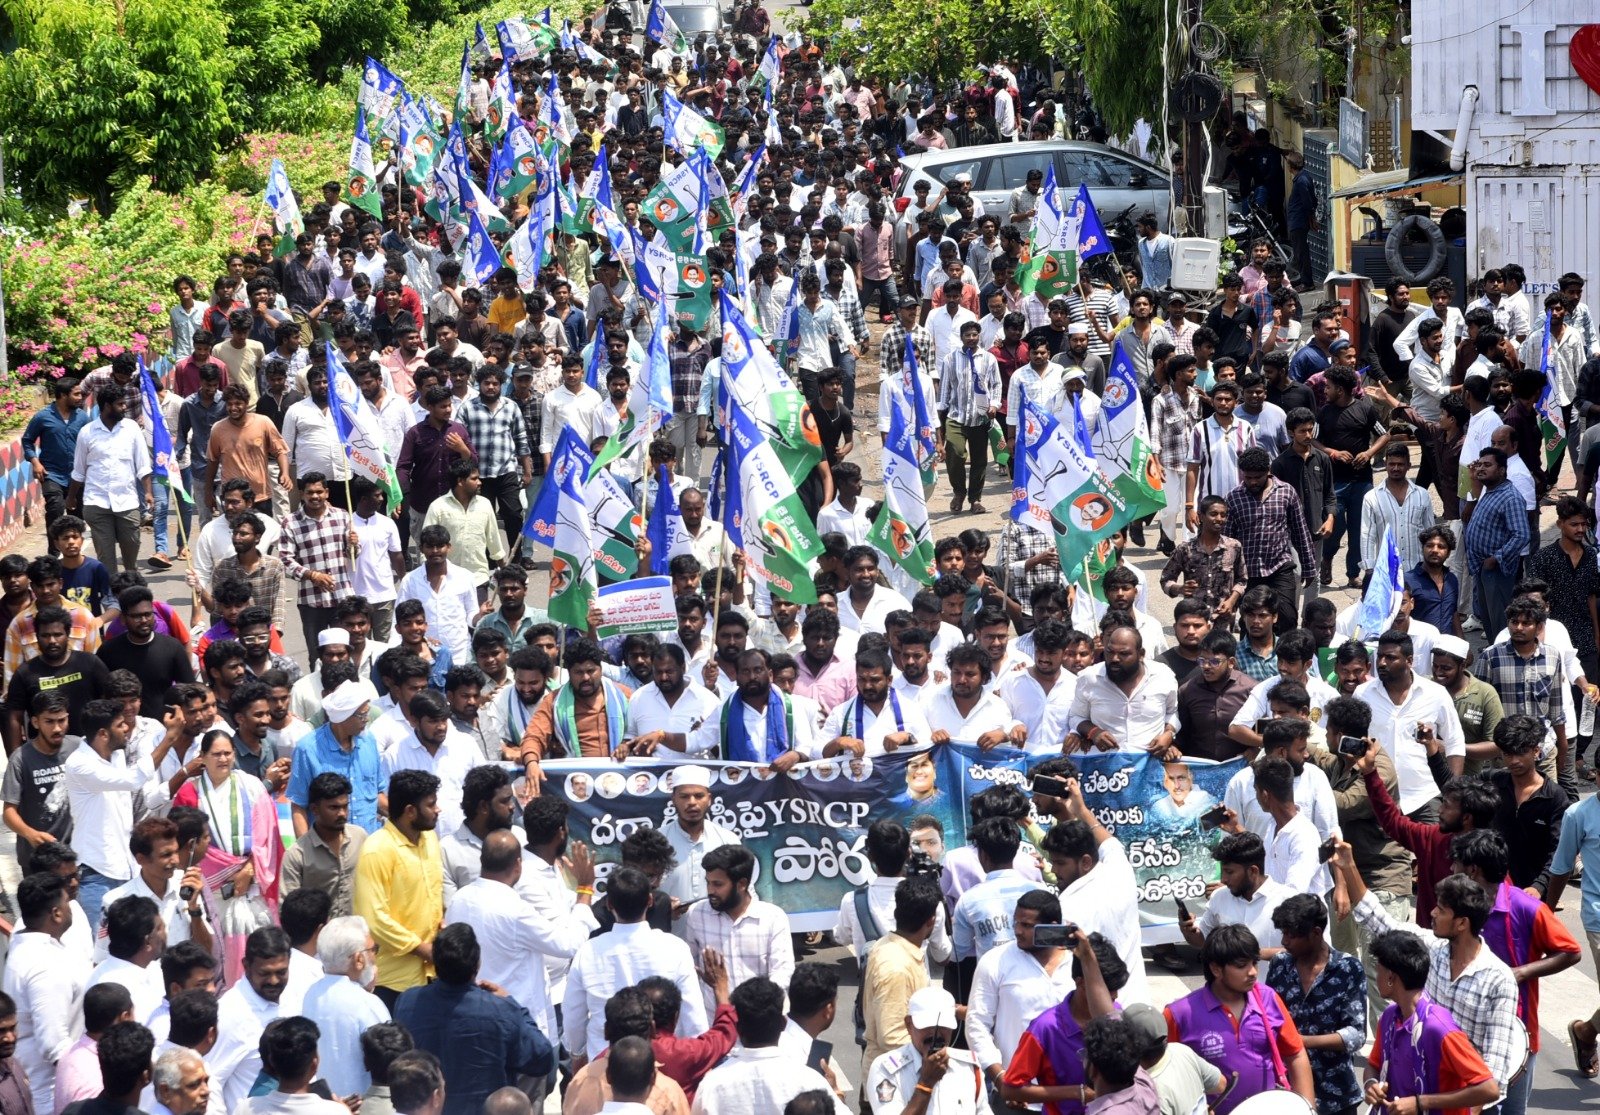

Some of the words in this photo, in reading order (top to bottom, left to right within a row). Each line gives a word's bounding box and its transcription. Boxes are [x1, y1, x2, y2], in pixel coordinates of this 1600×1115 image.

[1510, 24, 1556, 116] I
[1060, 219, 1069, 249] YSRCP
[1524, 283, 1559, 295] LET'S
[779, 309, 788, 339] YSRCP
[1056, 431, 1090, 473] YSRCP
[752, 452, 780, 499] YSRCP
[1084, 767, 1135, 793] చేతిలో
[764, 798, 870, 828] YSRCP
[978, 914, 1010, 938] BACK
